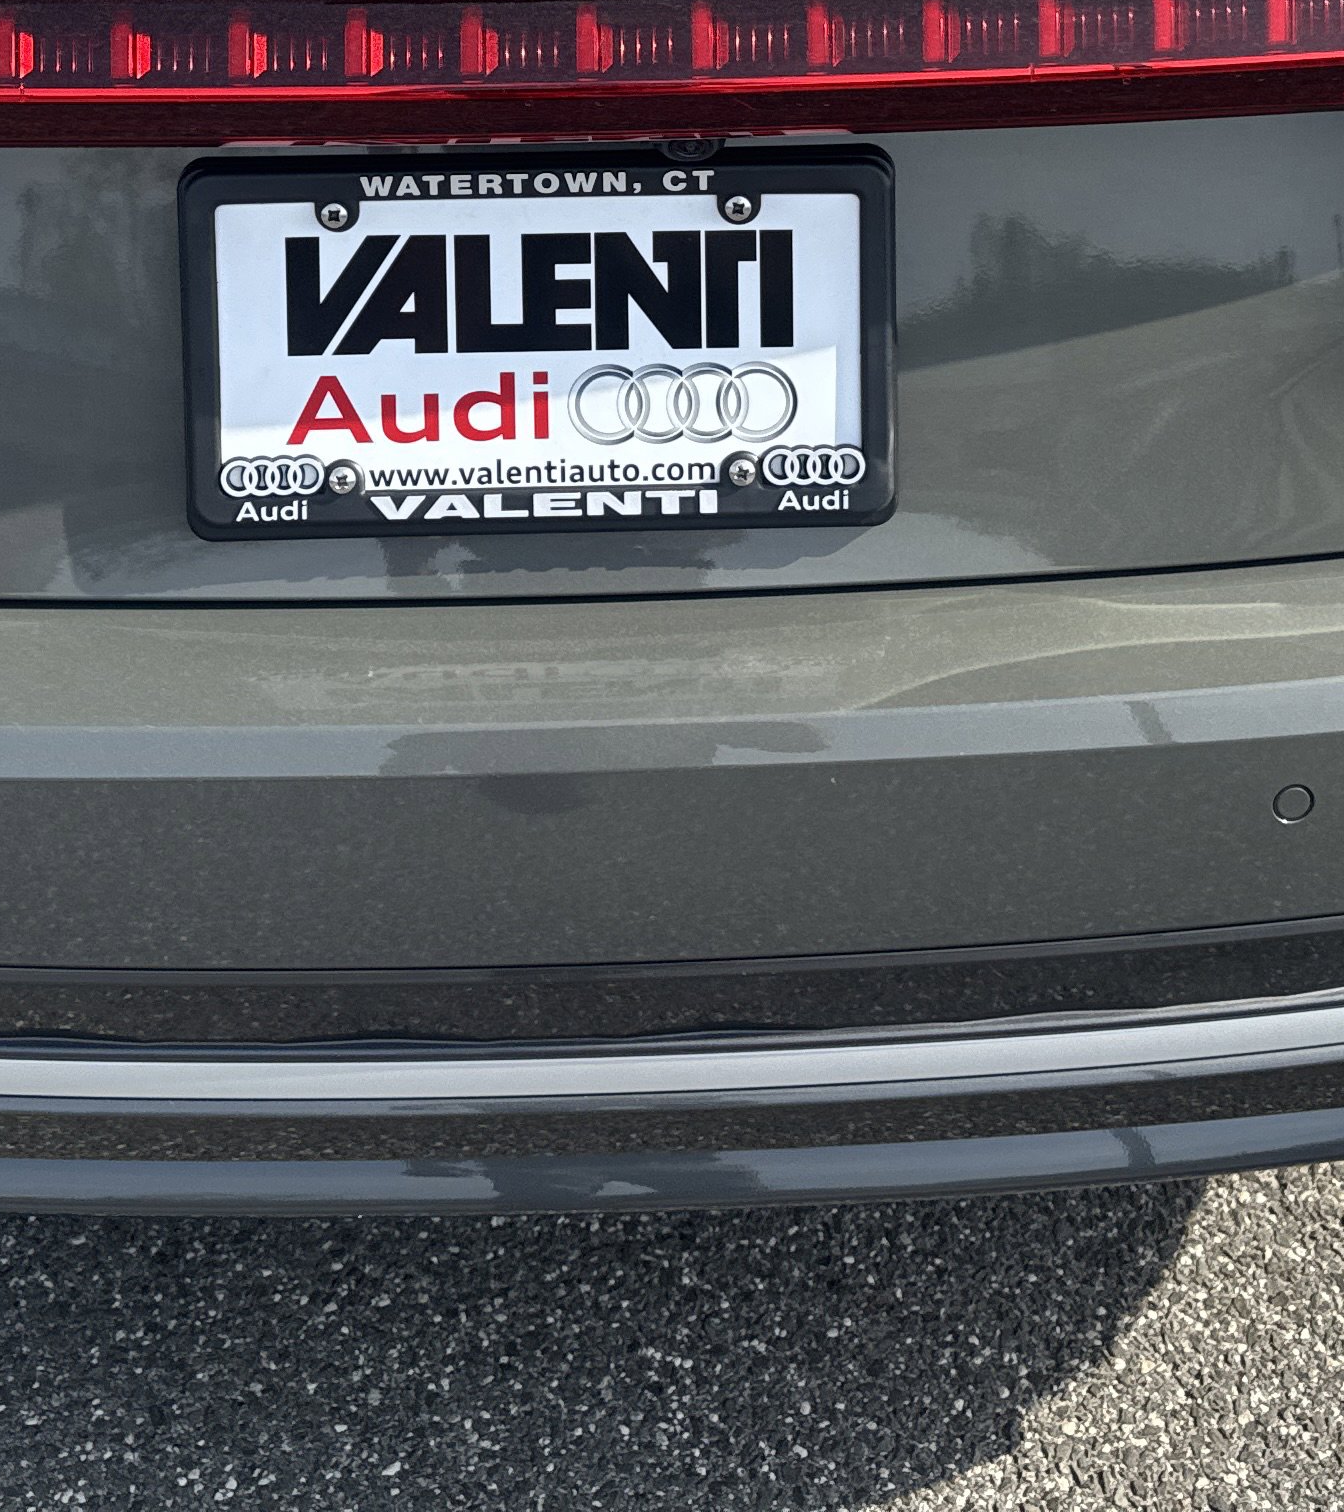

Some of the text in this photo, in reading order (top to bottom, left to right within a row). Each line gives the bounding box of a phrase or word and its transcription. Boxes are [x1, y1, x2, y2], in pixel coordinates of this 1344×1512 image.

[359, 170, 715, 197] WATERTOWN, CT
[285, 230, 793, 356] VALENTI
[286, 371, 550, 445] Audi
[369, 459, 716, 487] www.valentiauto.com
[236, 500, 308, 522] Audi
[370, 489, 718, 520] VALENTI
[778, 489, 849, 511] Audi
